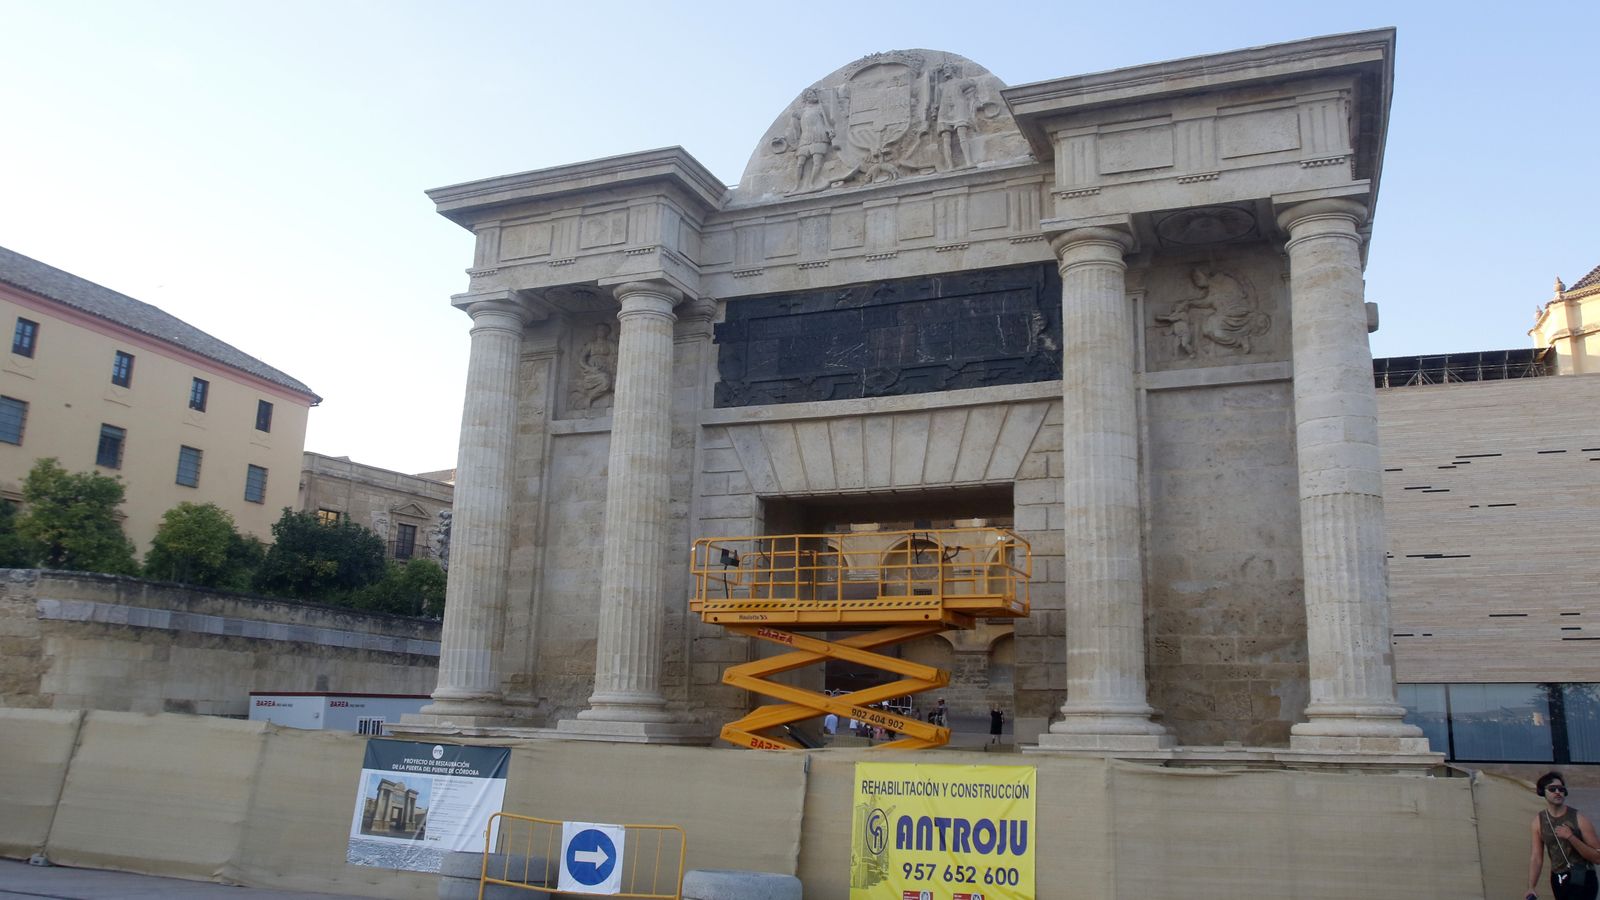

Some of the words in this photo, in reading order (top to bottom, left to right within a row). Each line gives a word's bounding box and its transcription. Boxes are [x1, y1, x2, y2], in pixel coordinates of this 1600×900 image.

[329, 700, 349, 708] BAREA
[851, 708, 867, 718] 902
[869, 714, 886, 724] 404
[887, 719, 904, 729] 902
[750, 737, 786, 750] BARE
[435, 760, 470, 768] RESTAURACIÓN
[861, 779, 939, 796] REHABILITACIÓN
[941, 783, 949, 796] Y
[950, 781, 1029, 799] CONSTRUCCIÓN
[896, 815, 1028, 856] ANTROJU
[903, 862, 936, 881] 957
[943, 865, 977, 883] 652
[983, 867, 1019, 886] 600
